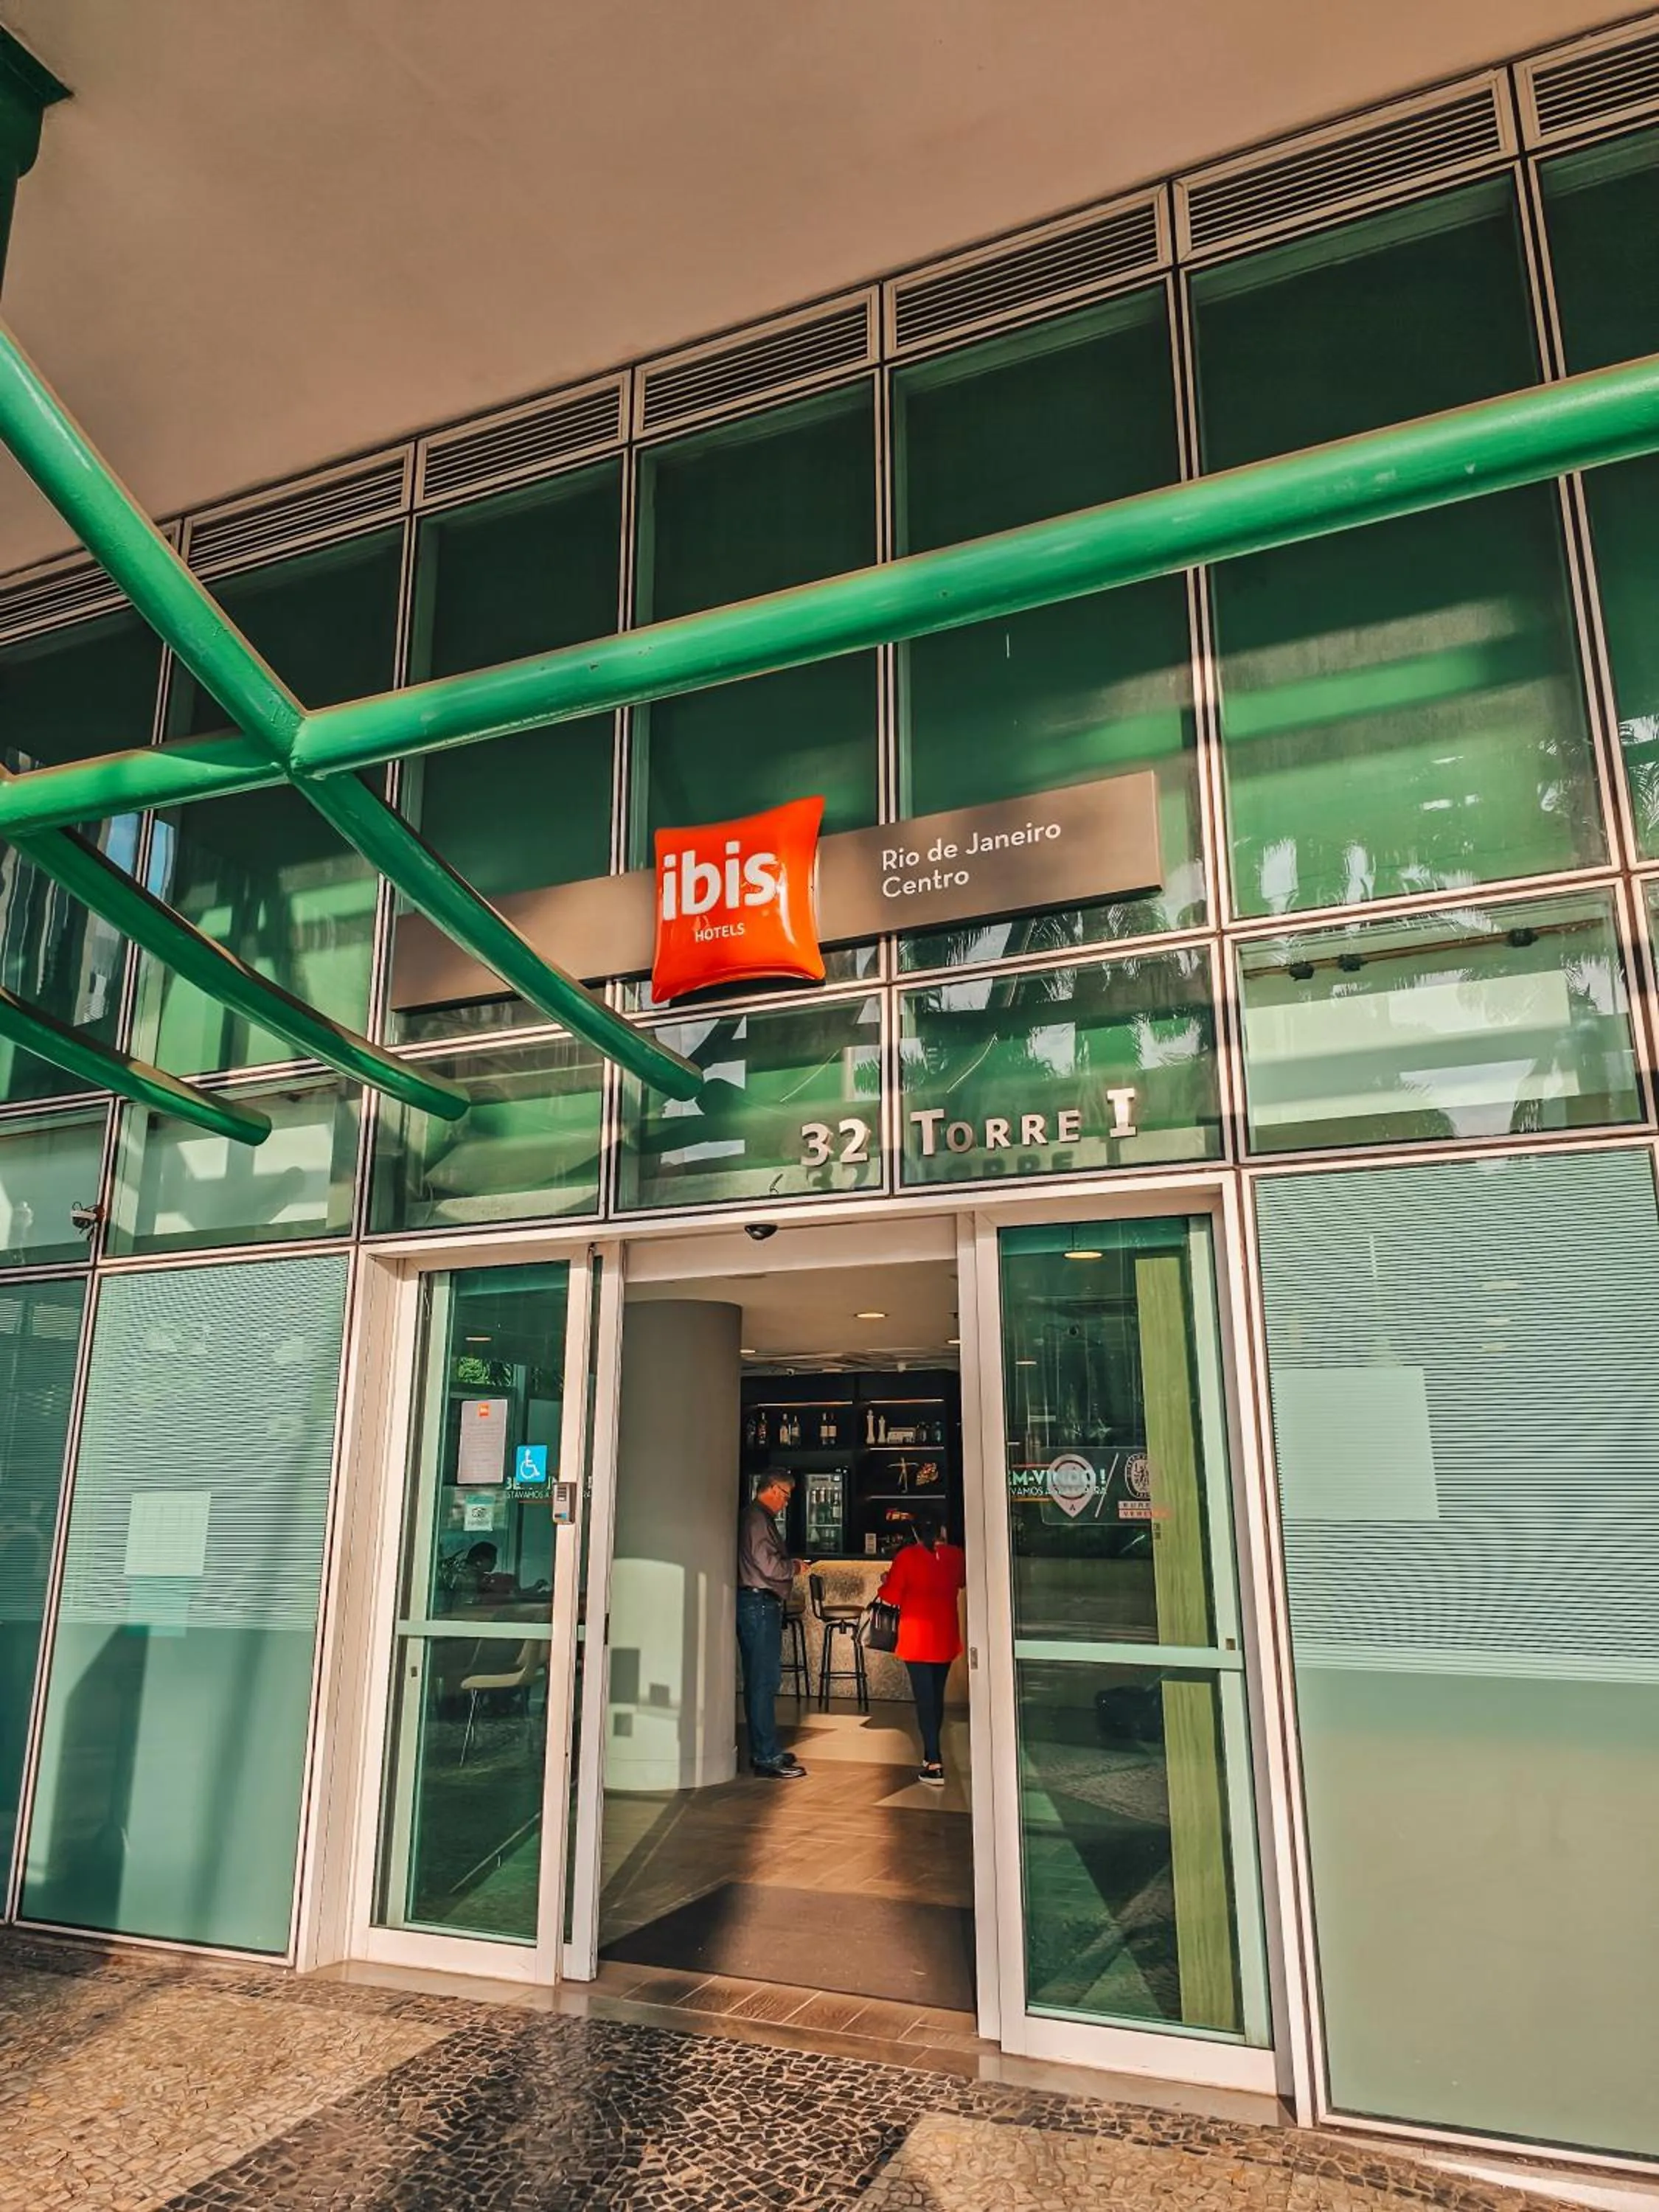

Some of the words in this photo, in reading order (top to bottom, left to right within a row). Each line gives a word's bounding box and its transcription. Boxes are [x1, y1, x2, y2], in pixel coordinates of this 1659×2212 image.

[882, 847, 920, 871] Rio
[927, 838, 959, 862] de
[965, 822, 1062, 855] Janeiro
[662, 840, 780, 920] ibis
[882, 869, 970, 898] Centro
[695, 922, 745, 943] HOTELS
[800, 1118, 871, 1167] 32
[909, 1107, 1082, 1157] TORRE
[1107, 1087, 1138, 1138] I
